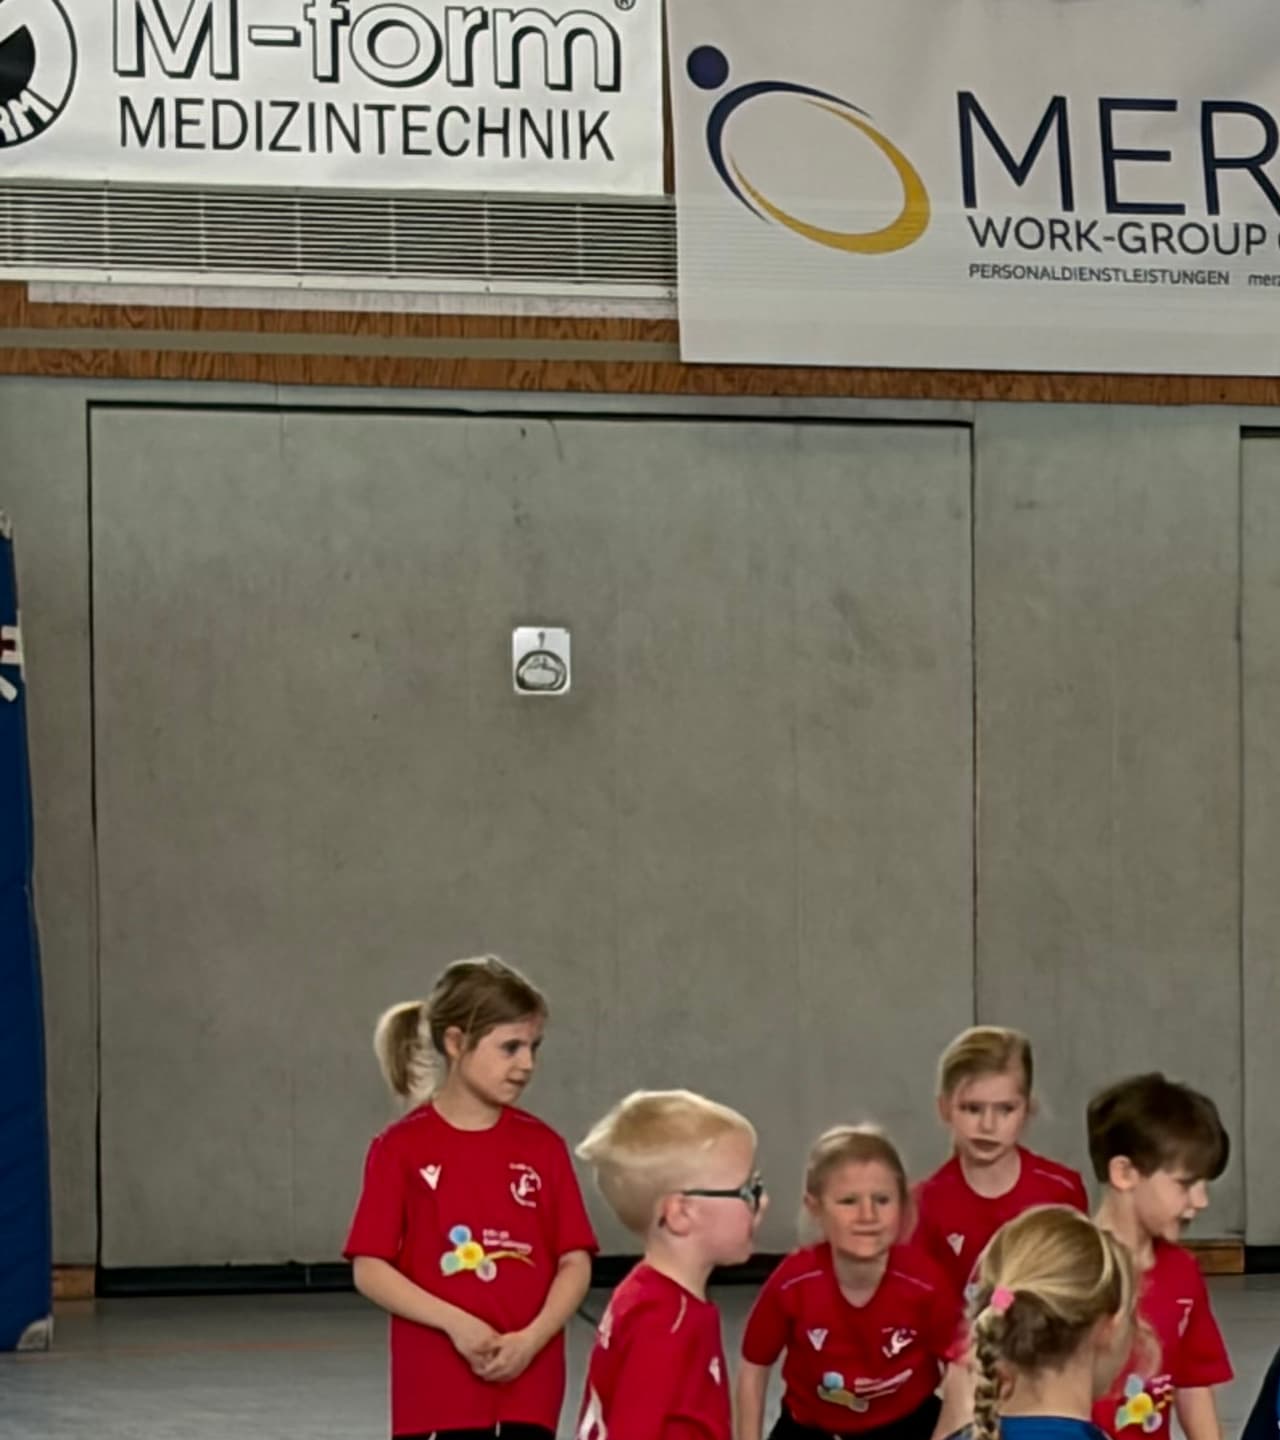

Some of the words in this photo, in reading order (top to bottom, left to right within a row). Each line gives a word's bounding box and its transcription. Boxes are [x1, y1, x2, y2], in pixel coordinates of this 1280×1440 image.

[118, 96, 616, 161] MEDIZINTECHNIK
[966, 214, 1268, 257] WORK-GROUP
[968, 263, 1230, 286] PERSONALDIENSTLEISTUNGEN
